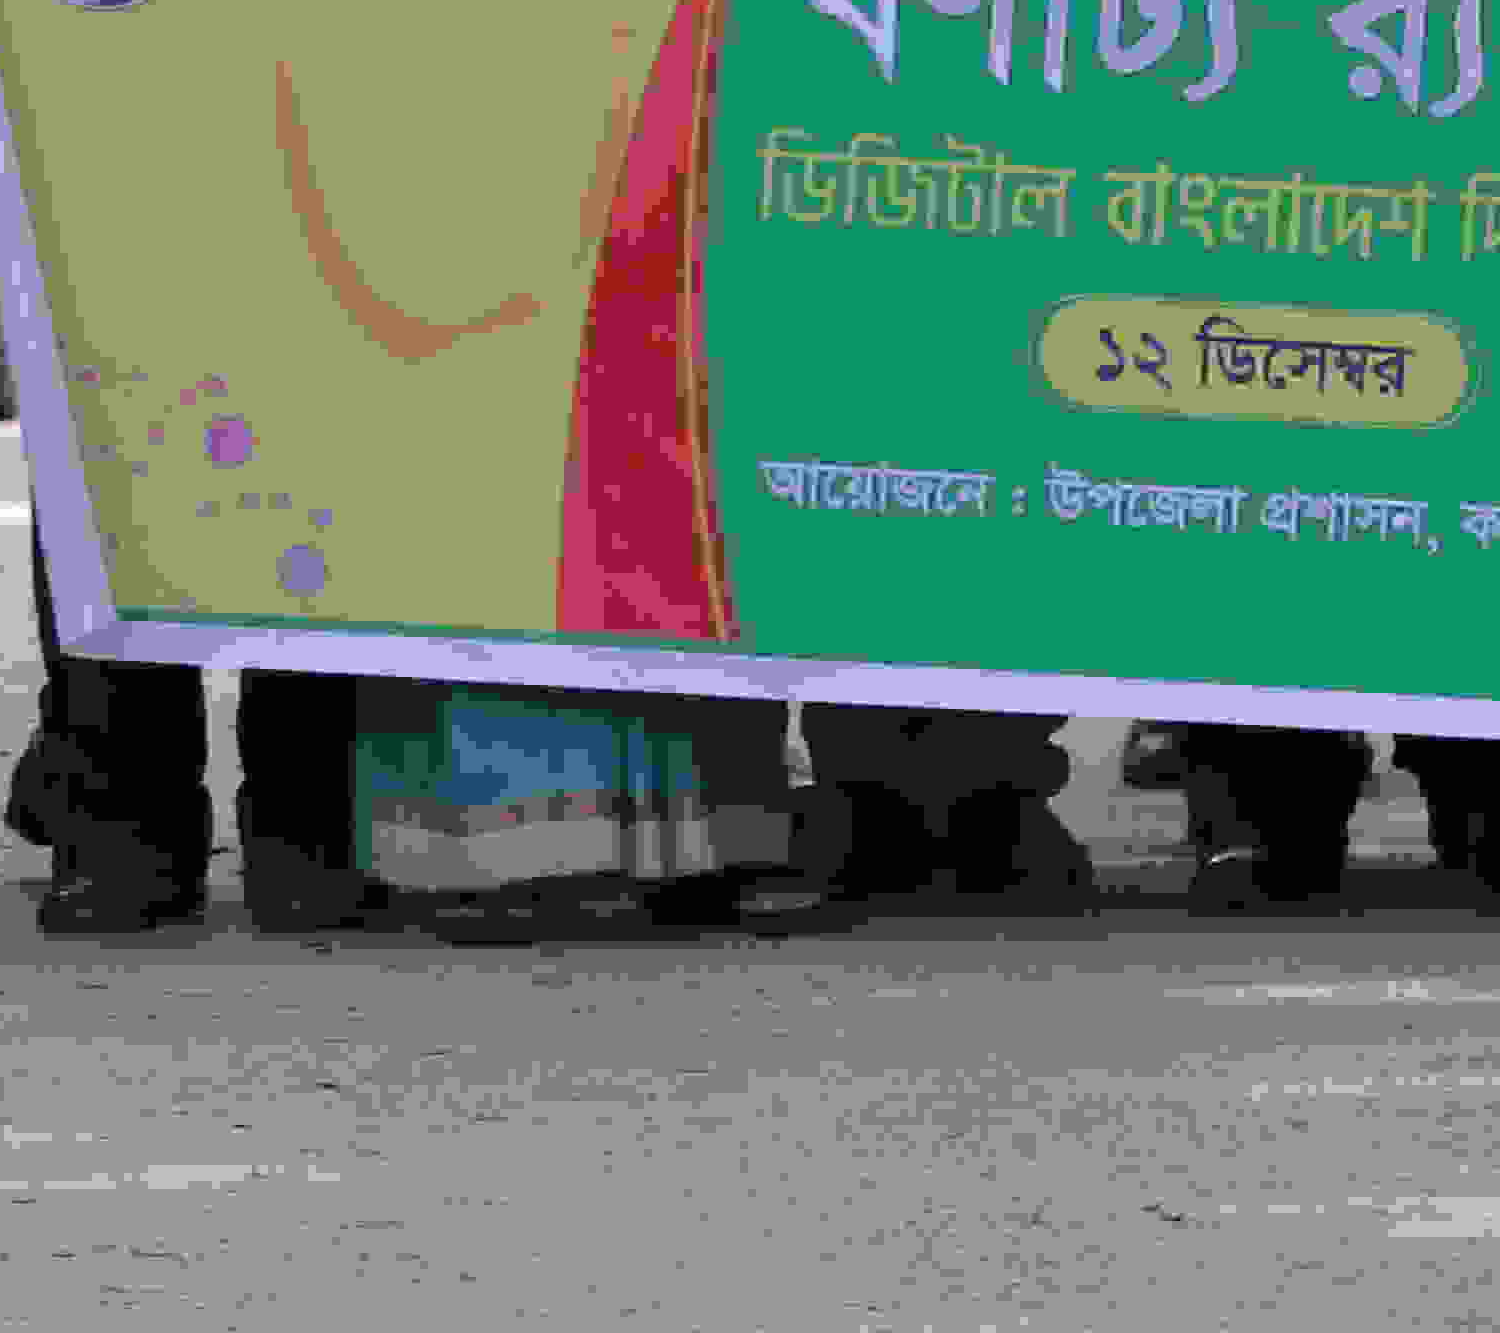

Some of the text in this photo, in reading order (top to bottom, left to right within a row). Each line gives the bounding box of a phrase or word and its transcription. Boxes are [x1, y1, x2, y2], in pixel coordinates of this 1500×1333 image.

[755, 125, 1077, 238] ডিজিটাল
[1103, 157, 1435, 261] বাংলাদেশ
[1096, 316, 1415, 398] ১২ ডিসেম্বর
[756, 455, 997, 517] আয়োজনে
[1044, 460, 1255, 534] উপজেলা
